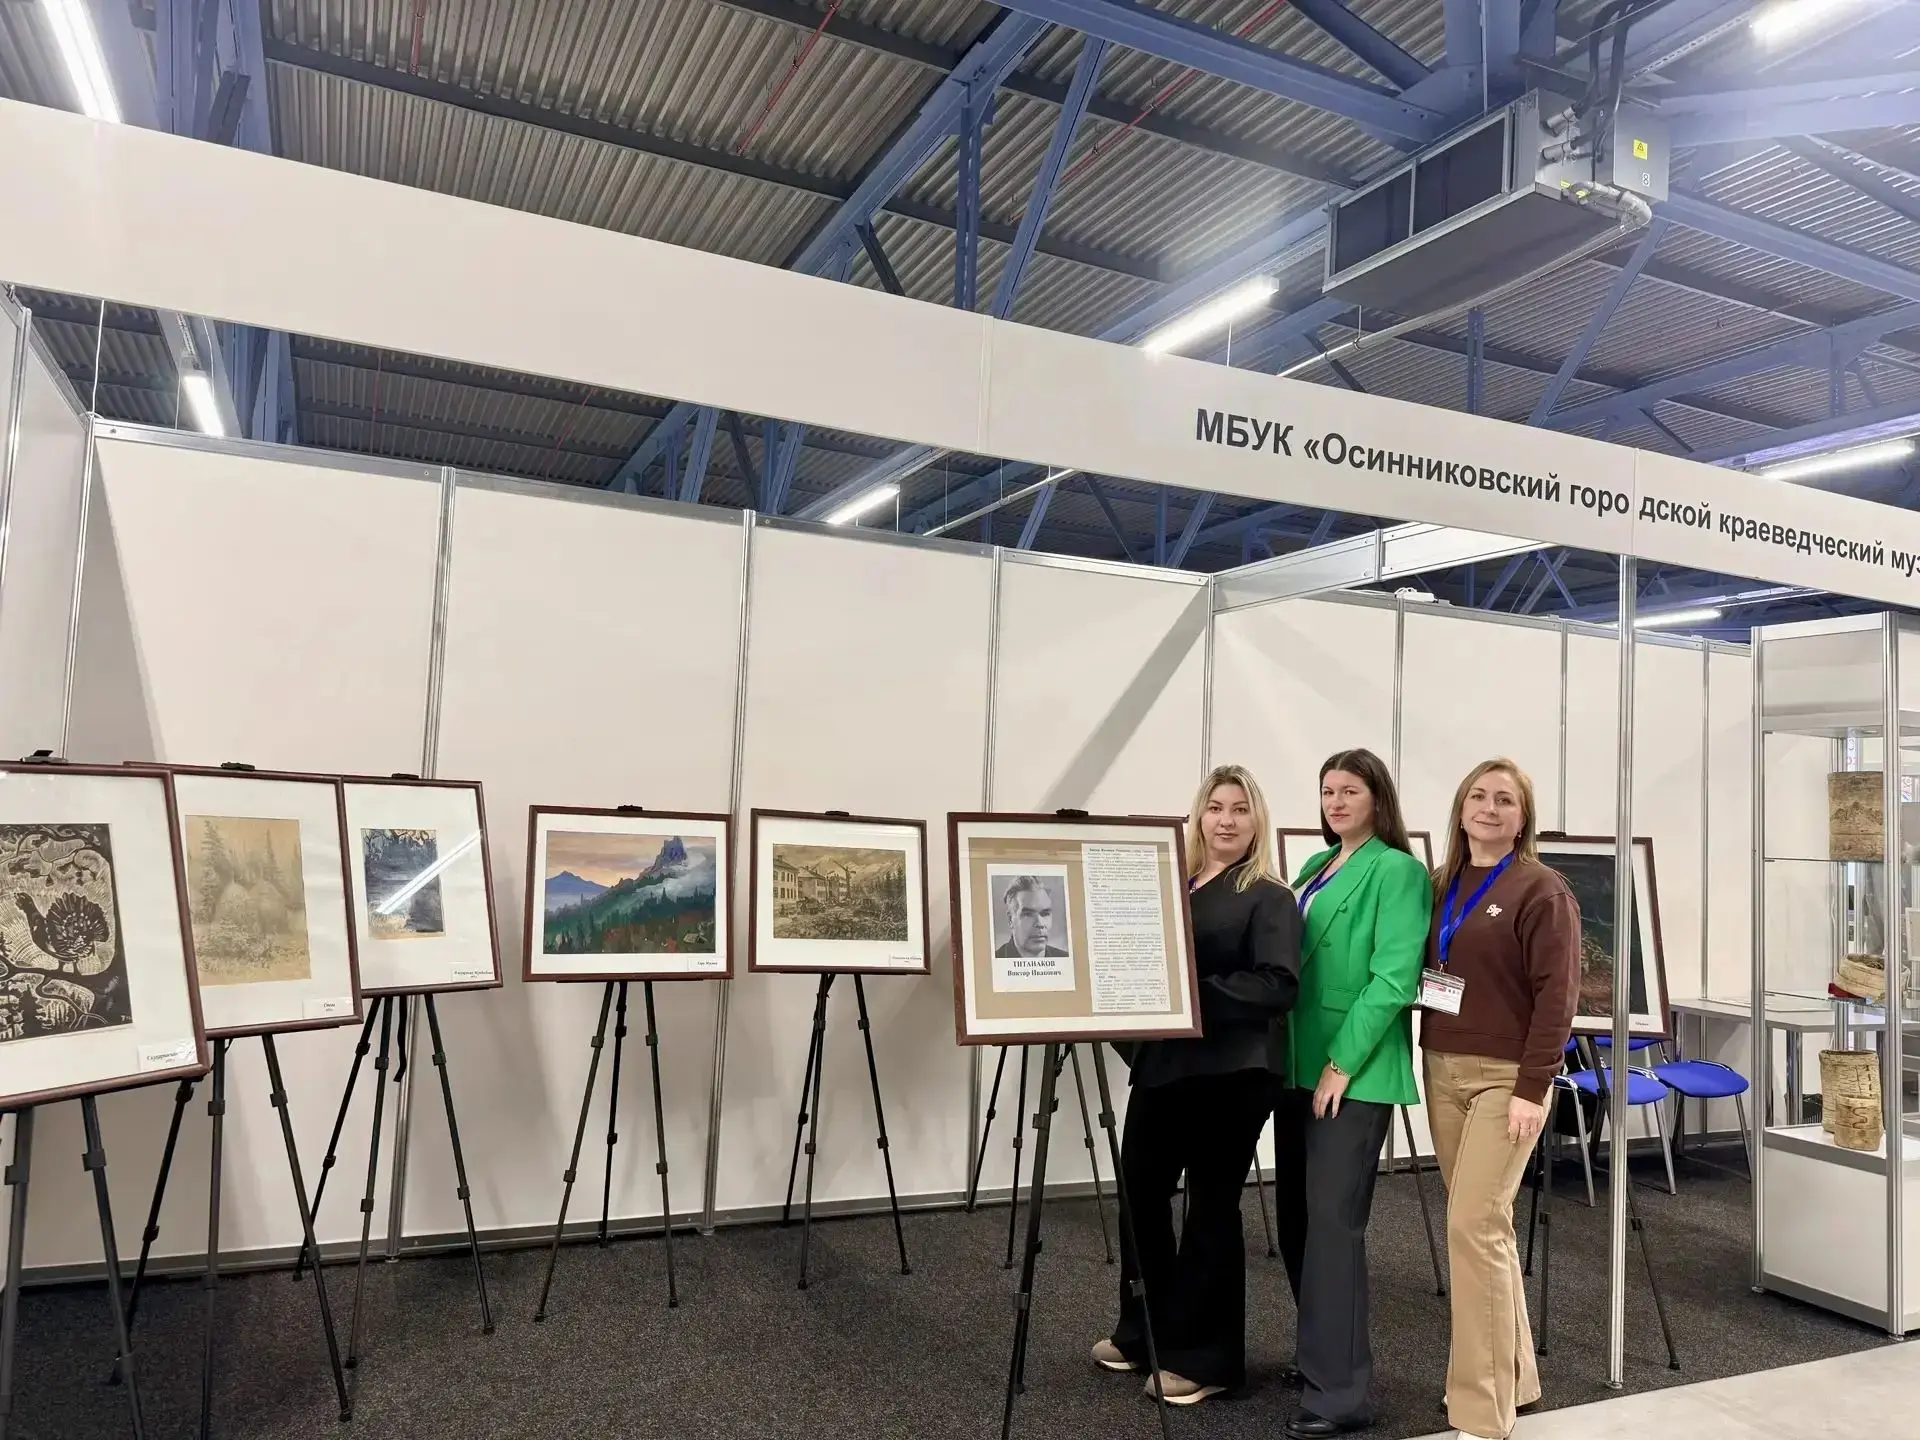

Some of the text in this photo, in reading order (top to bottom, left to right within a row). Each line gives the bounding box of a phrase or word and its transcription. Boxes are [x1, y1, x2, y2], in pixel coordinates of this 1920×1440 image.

[1196, 408, 1294, 457] МБУК
[1303, 432, 1561, 503] «Осинниковский
[1570, 484, 1630, 518] горо
[1638, 496, 1711, 530] дской
[1719, 513, 1884, 566] краеведческий
